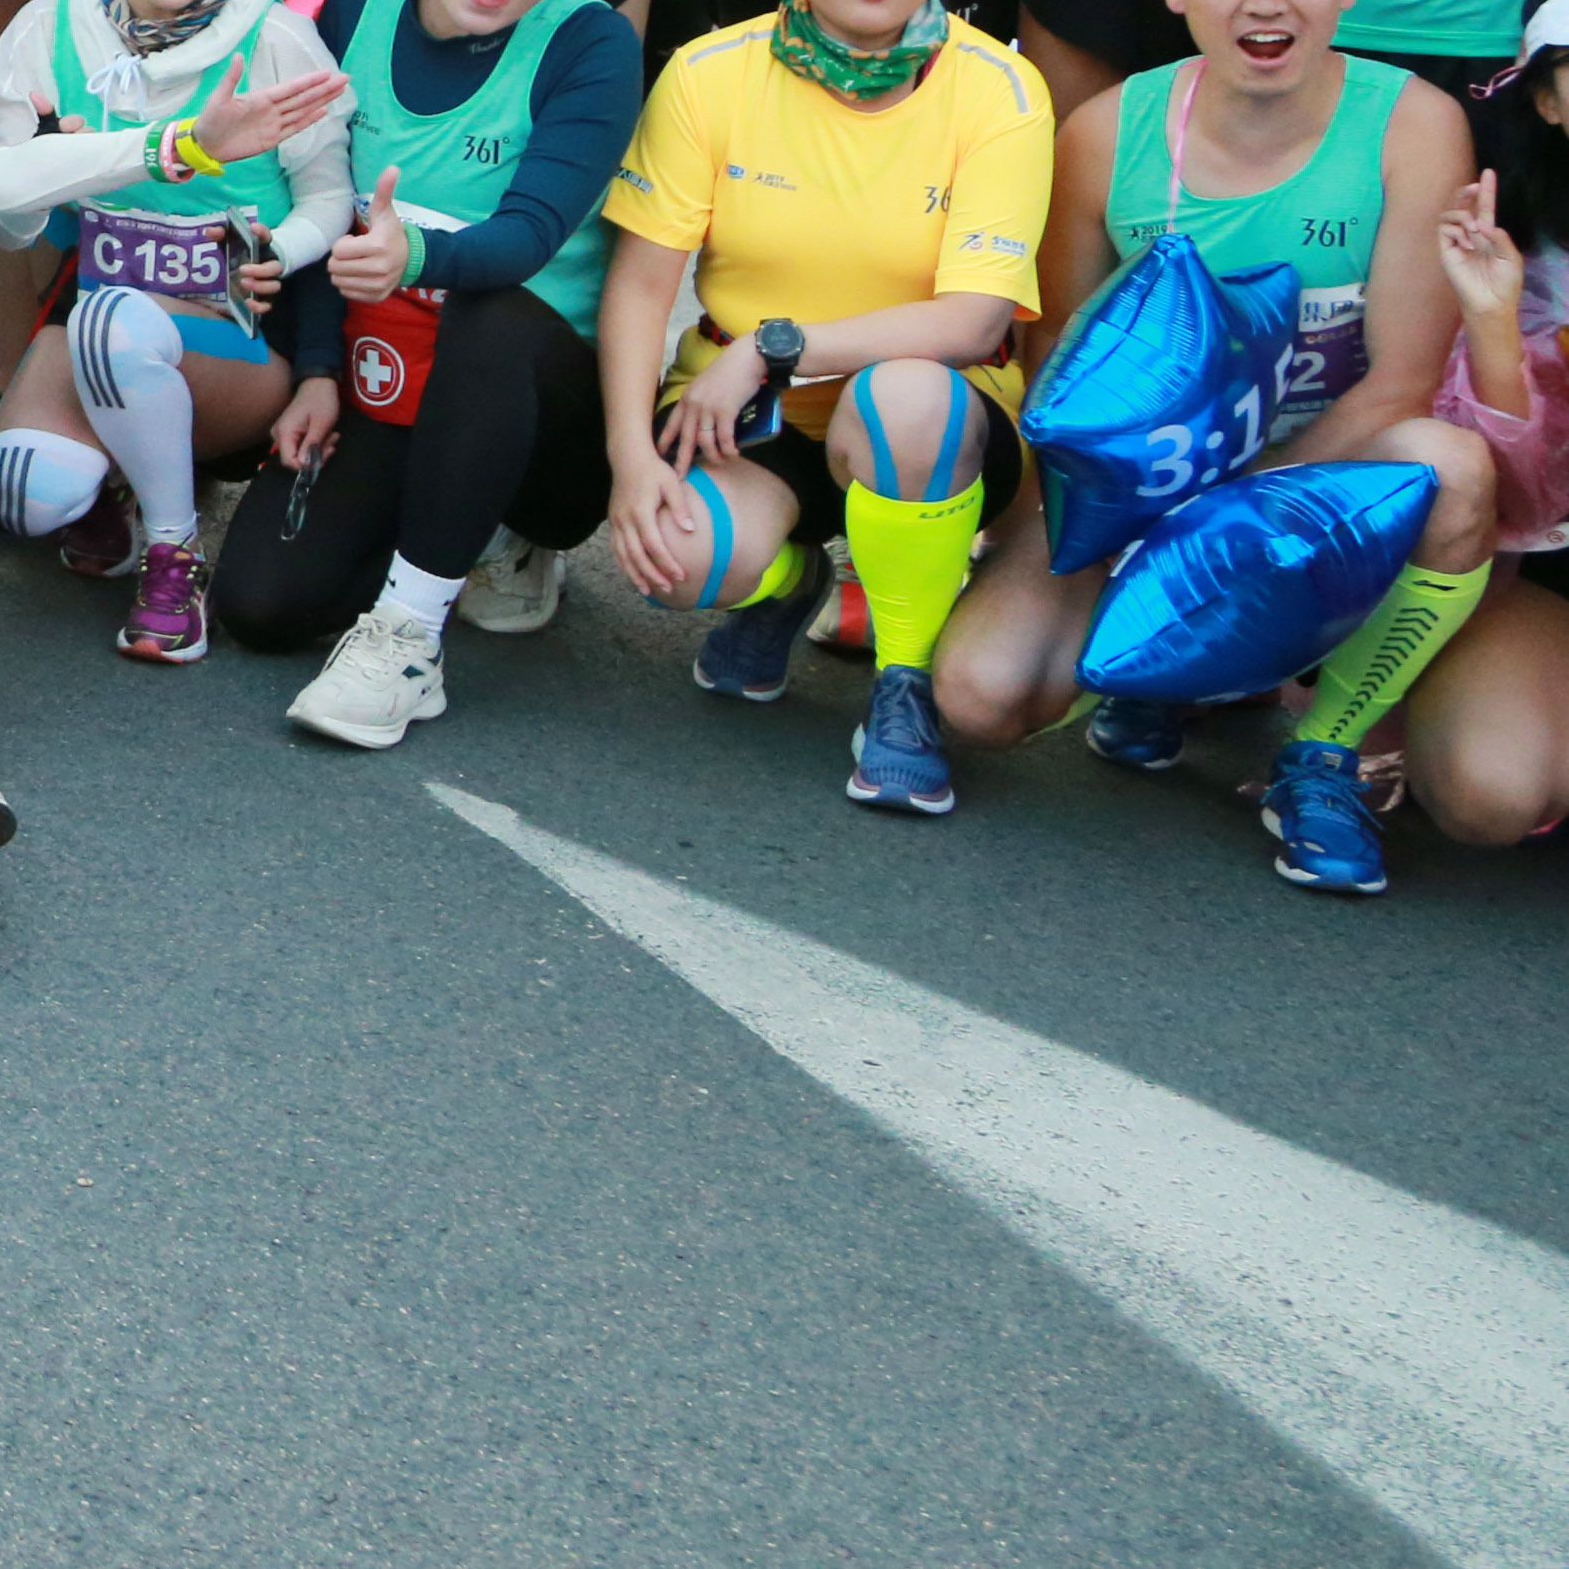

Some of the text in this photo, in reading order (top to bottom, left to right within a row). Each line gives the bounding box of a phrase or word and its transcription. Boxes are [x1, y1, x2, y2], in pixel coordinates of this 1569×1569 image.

[463, 135, 512, 166] 361°
[1300, 216, 1359, 248] 361°
[93, 232, 220, 284] C 135
